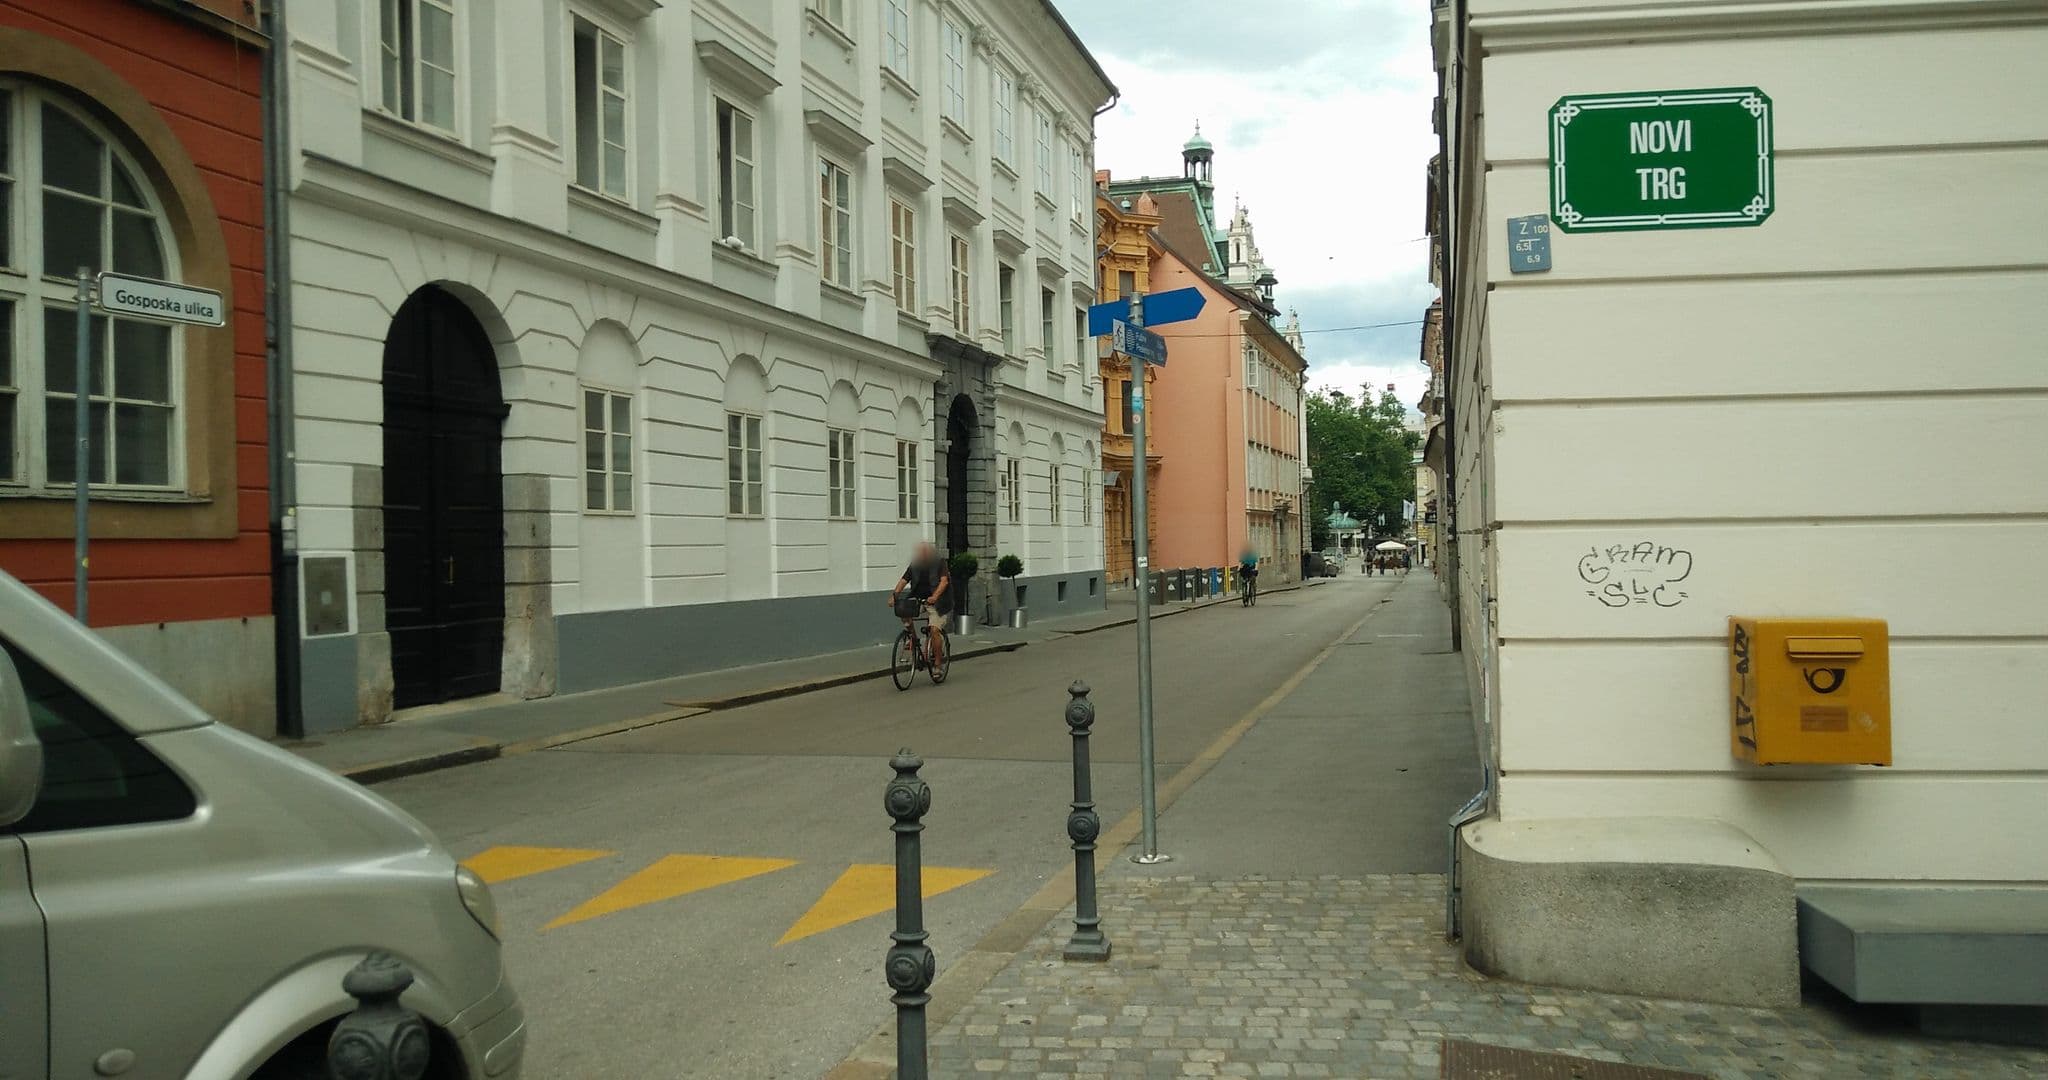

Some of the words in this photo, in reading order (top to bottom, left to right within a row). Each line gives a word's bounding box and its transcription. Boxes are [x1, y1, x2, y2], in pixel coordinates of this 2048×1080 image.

[1629, 119, 1692, 154] NOVI
[1636, 167, 1686, 201] TRG
[1519, 222, 1528, 235] Z
[1533, 225, 1549, 234] 100
[115, 289, 181, 313] Gosposka
[184, 302, 214, 318] ulica
